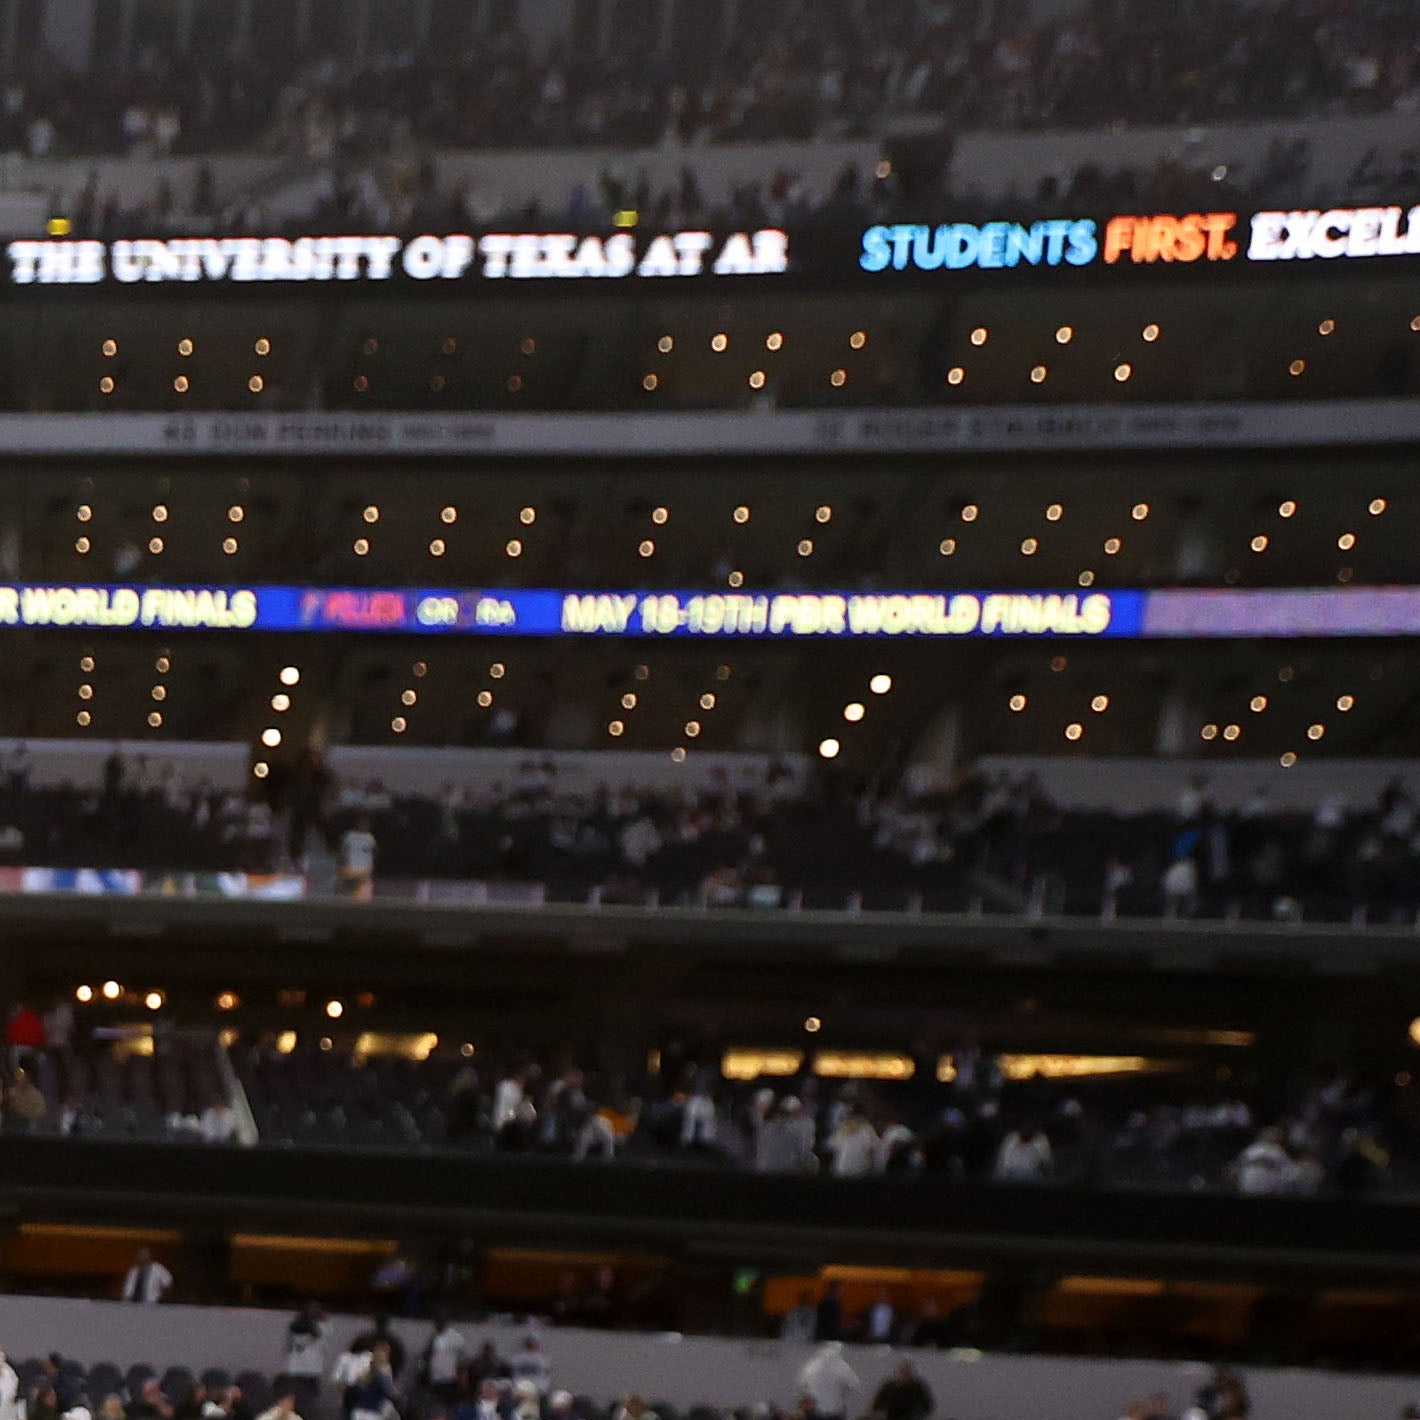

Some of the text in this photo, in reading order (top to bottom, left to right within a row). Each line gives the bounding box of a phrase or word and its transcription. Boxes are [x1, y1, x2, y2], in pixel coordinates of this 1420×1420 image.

[7, 240, 106, 283] THE
[111, 236, 402, 283] UNIVERSITY
[403, 234, 474, 280] OF
[479, 233, 635, 279] TEXAS
[637, 231, 712, 277] AT
[860, 218, 1098, 271] STUDENTS
[1104, 212, 1238, 264] FIRST.
[21, 587, 139, 626] WORLD
[140, 588, 257, 628] FINALS
[561, 594, 637, 634] MAY
[847, 593, 980, 635] WORLD
[982, 593, 1111, 634] FINALS
